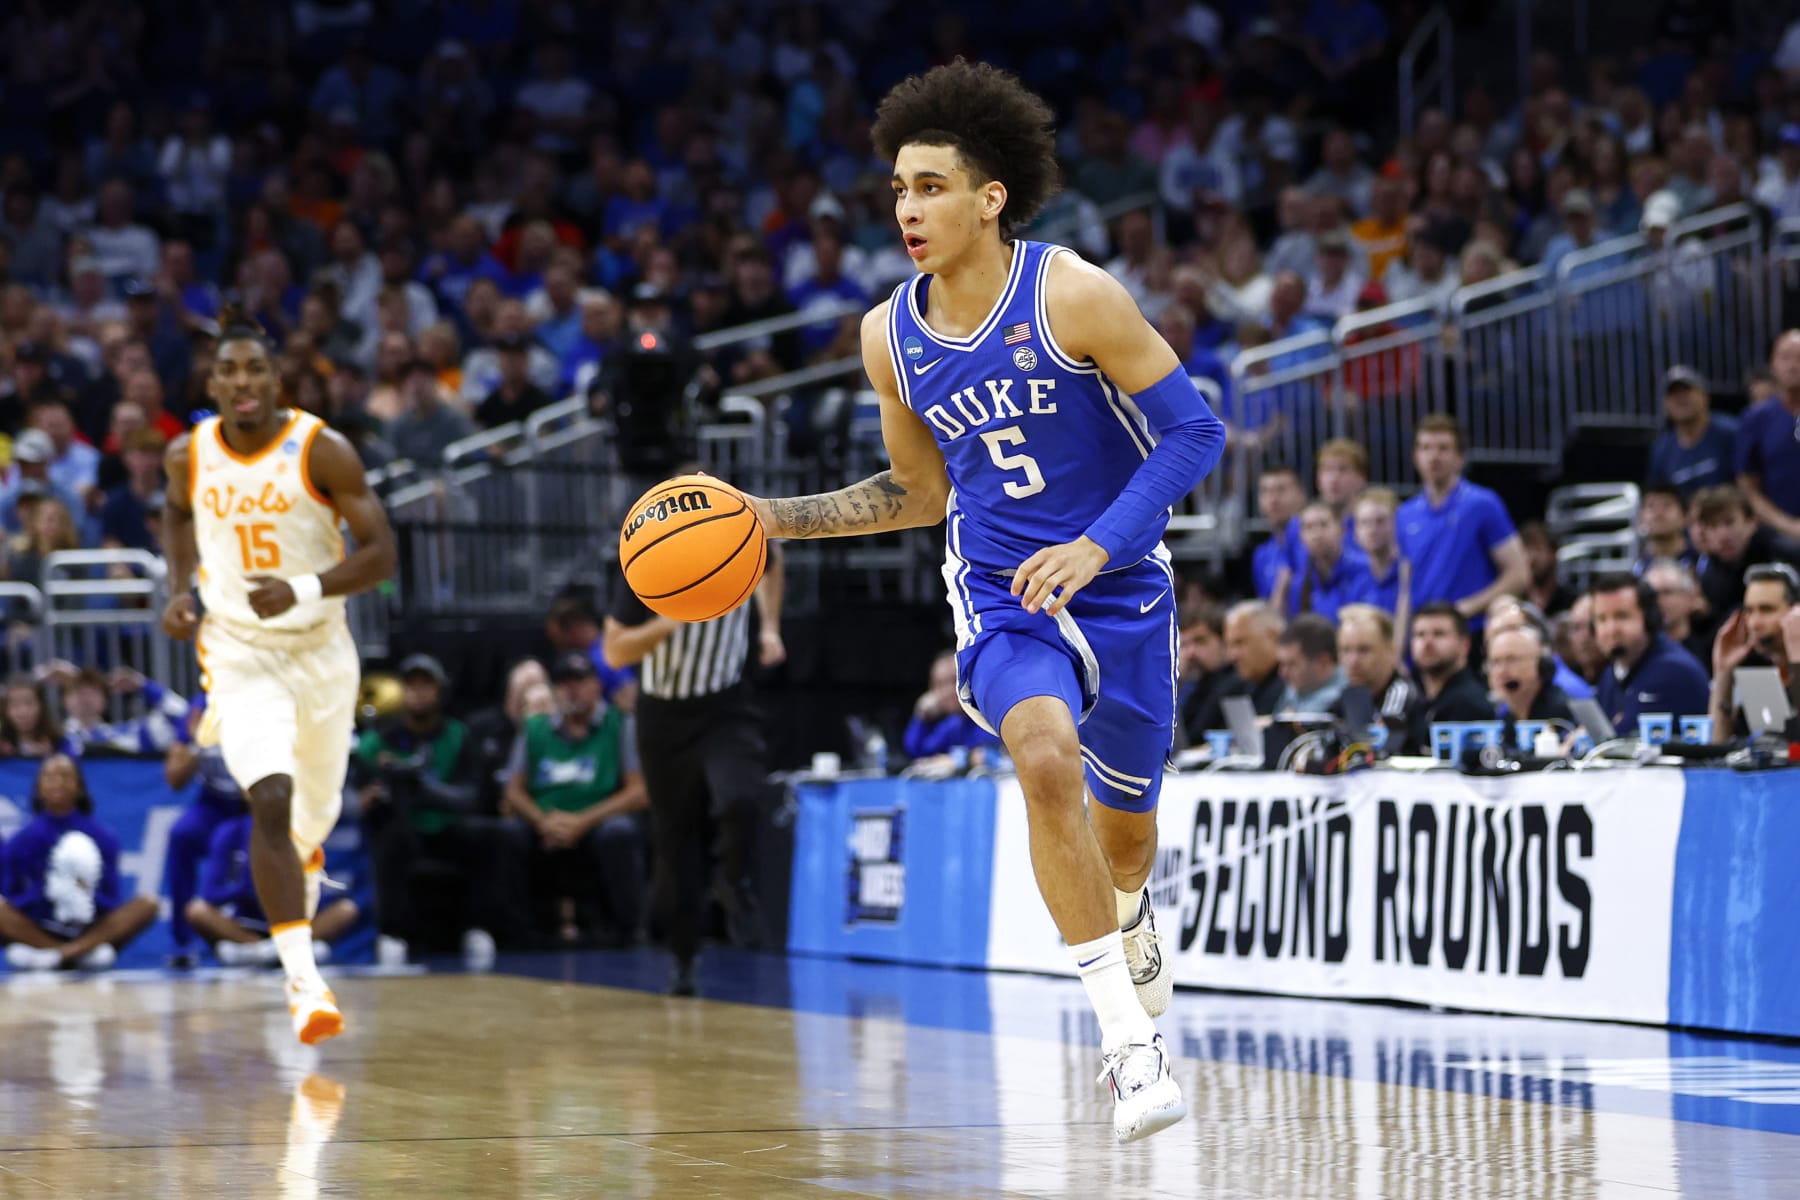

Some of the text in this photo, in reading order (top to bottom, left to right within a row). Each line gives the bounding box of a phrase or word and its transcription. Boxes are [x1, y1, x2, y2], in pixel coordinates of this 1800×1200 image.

[924, 378, 1057, 441] DUKE
[979, 425, 1046, 500] 5
[203, 481, 298, 520] Vols
[624, 491, 712, 542] Wilson
[233, 522, 281, 572] 15
[1178, 798, 1352, 963] SECOND
[1374, 799, 1594, 979] ROUNDS
